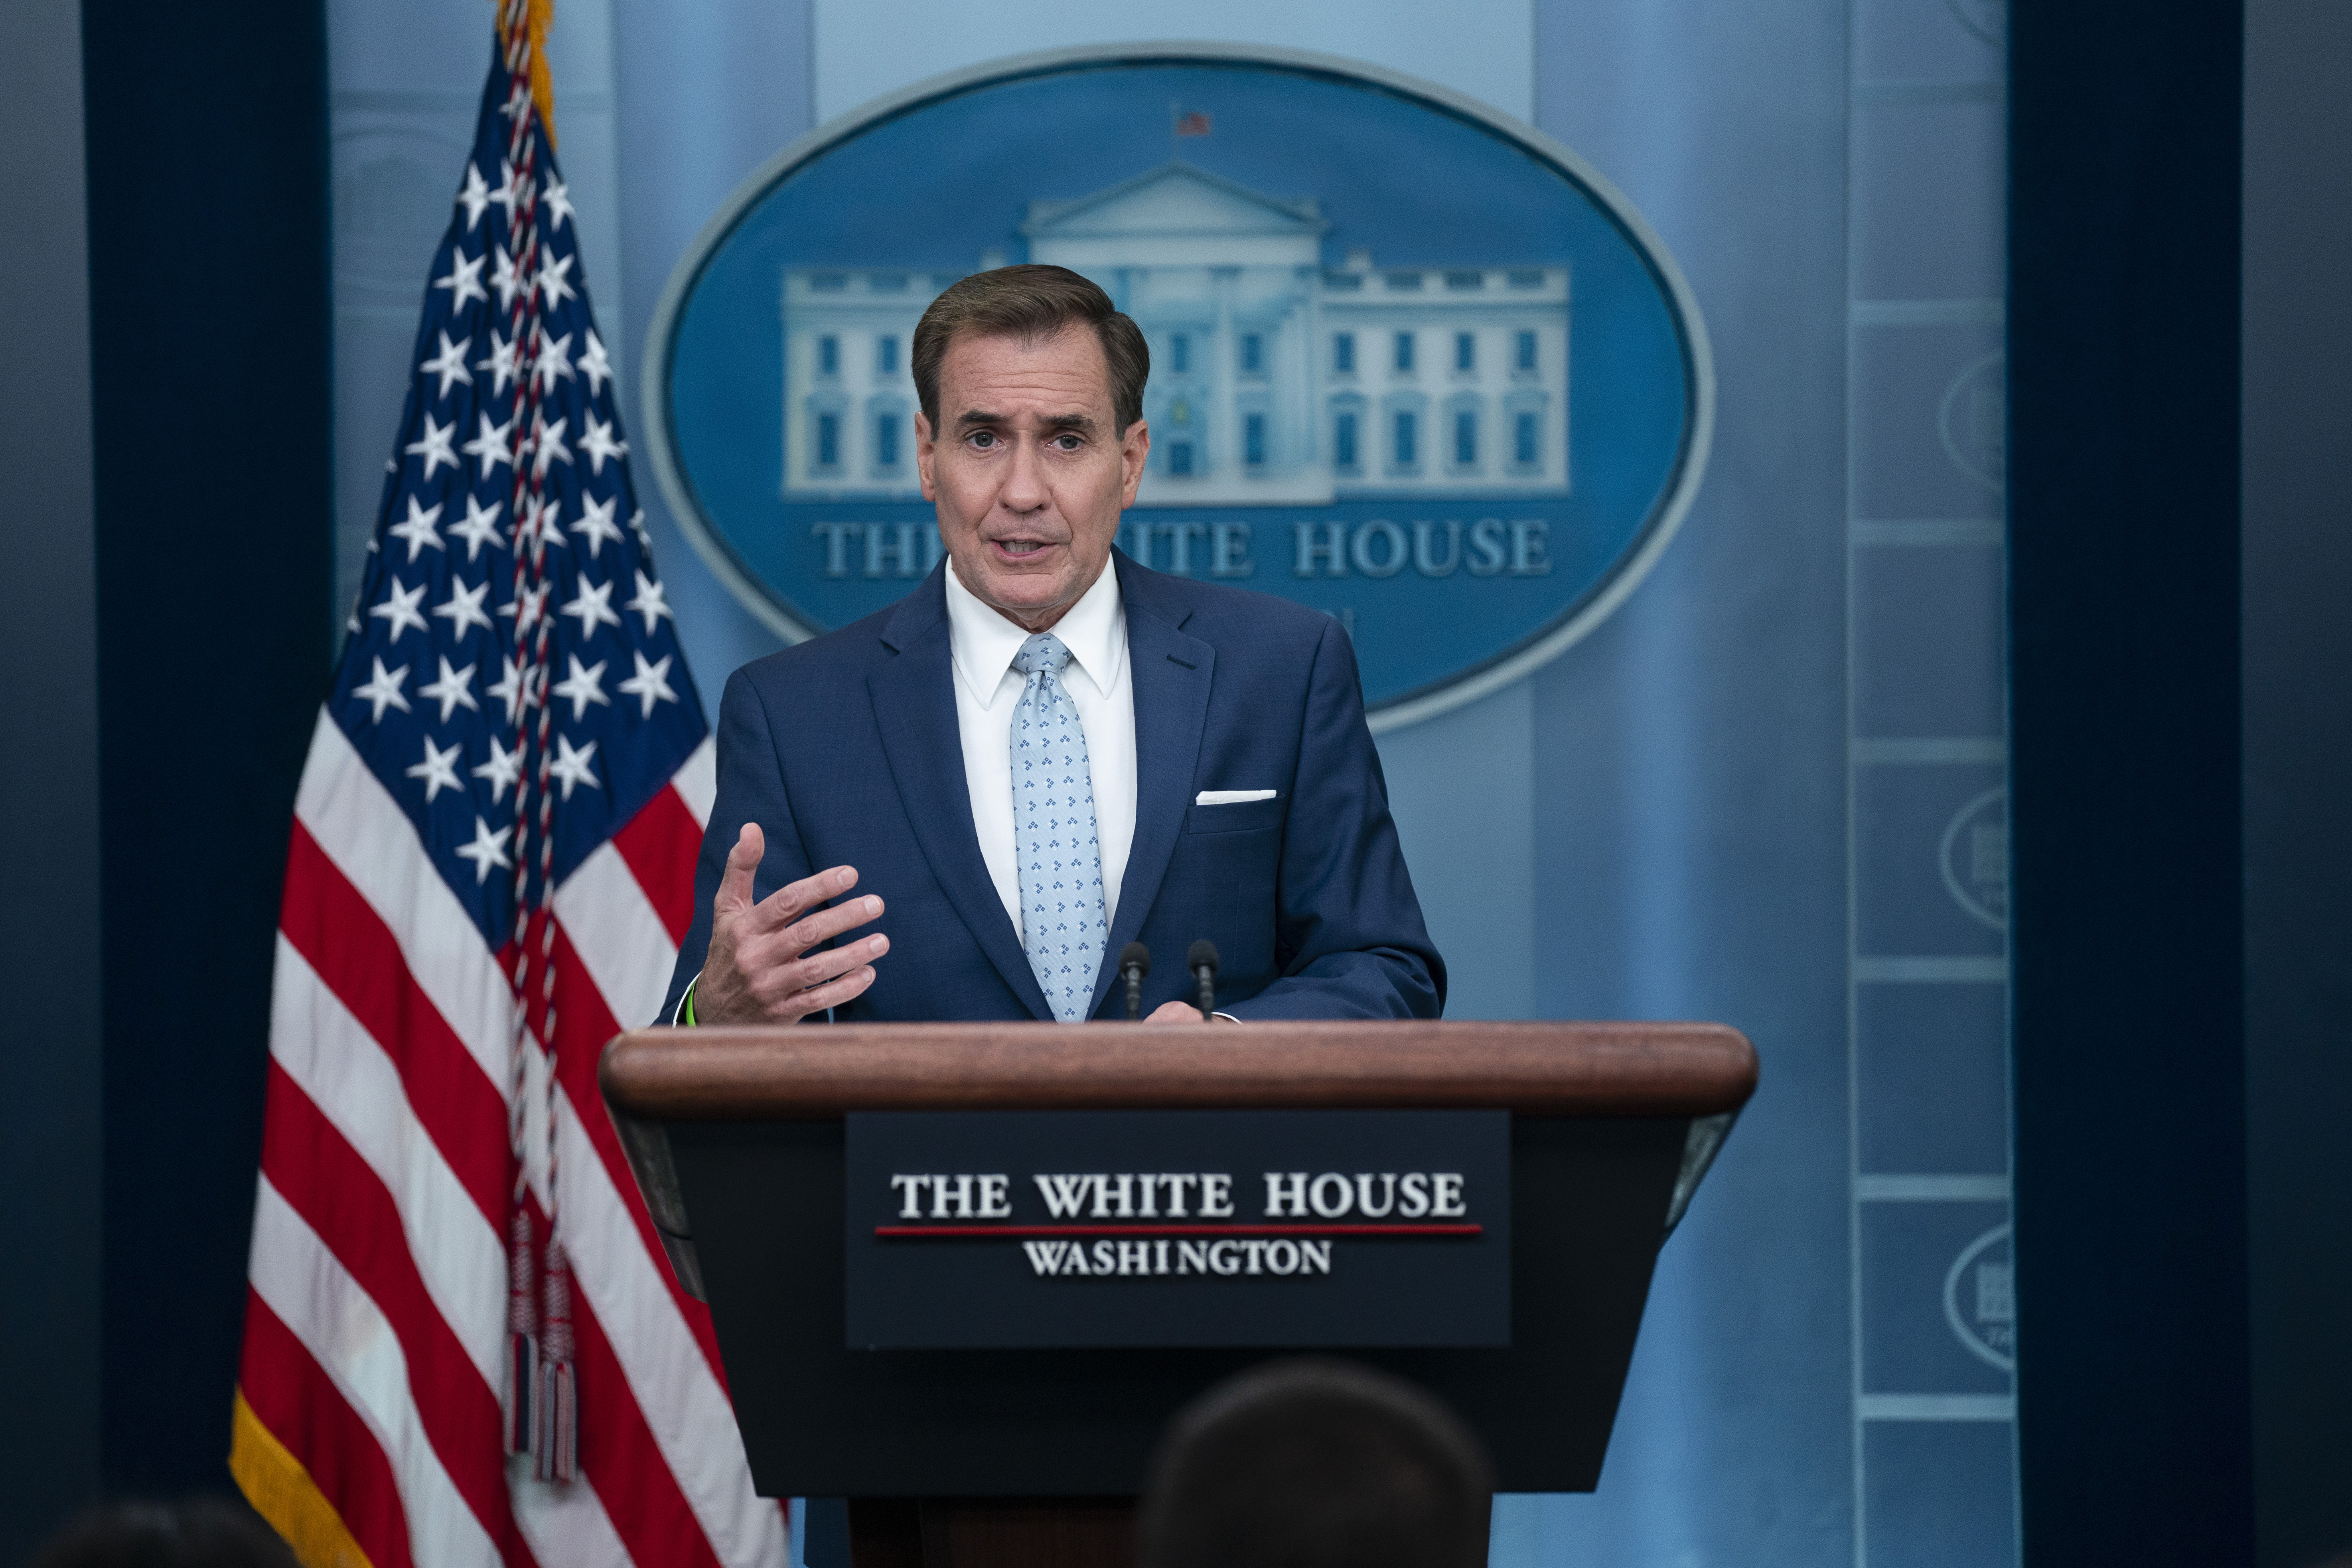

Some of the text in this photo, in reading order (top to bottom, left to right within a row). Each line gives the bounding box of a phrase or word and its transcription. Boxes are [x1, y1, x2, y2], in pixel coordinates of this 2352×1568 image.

[1113, 521, 1255, 578] ITE
[1294, 519, 1553, 577] HOUSE
[890, 1172, 1467, 1219] THE WHITE HOUSE
[1021, 1239, 1332, 1276] WASHINGTON
